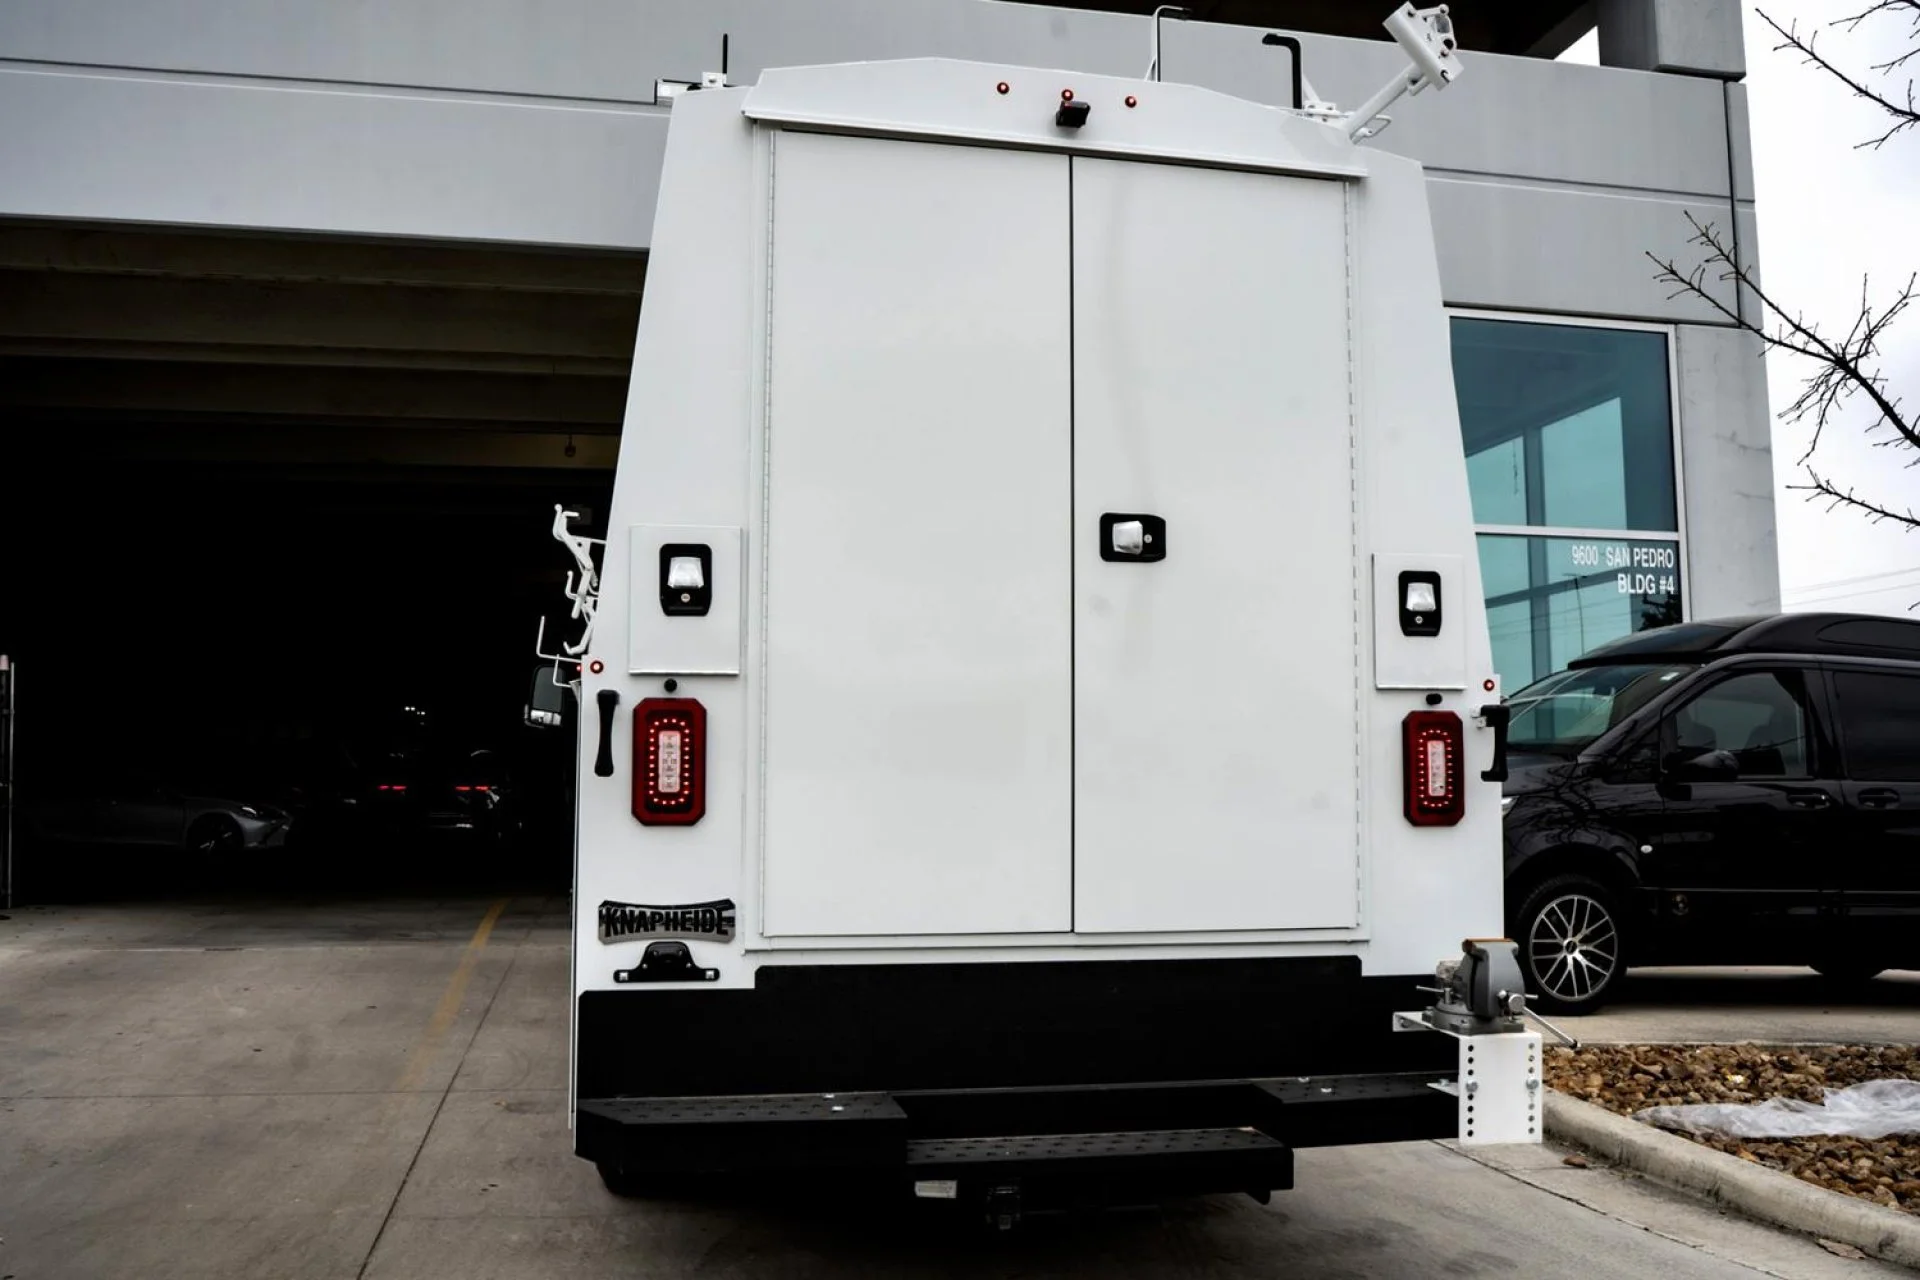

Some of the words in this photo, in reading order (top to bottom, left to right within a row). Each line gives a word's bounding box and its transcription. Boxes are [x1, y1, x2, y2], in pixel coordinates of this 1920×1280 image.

[1571, 546, 1599, 566] 9600
[1605, 547, 1631, 567] SAN
[1633, 548, 1674, 568] PEDRO
[1617, 573, 1656, 595] BLDG
[1659, 575, 1675, 595] #4
[605, 906, 730, 938] KNAPHEIDE
